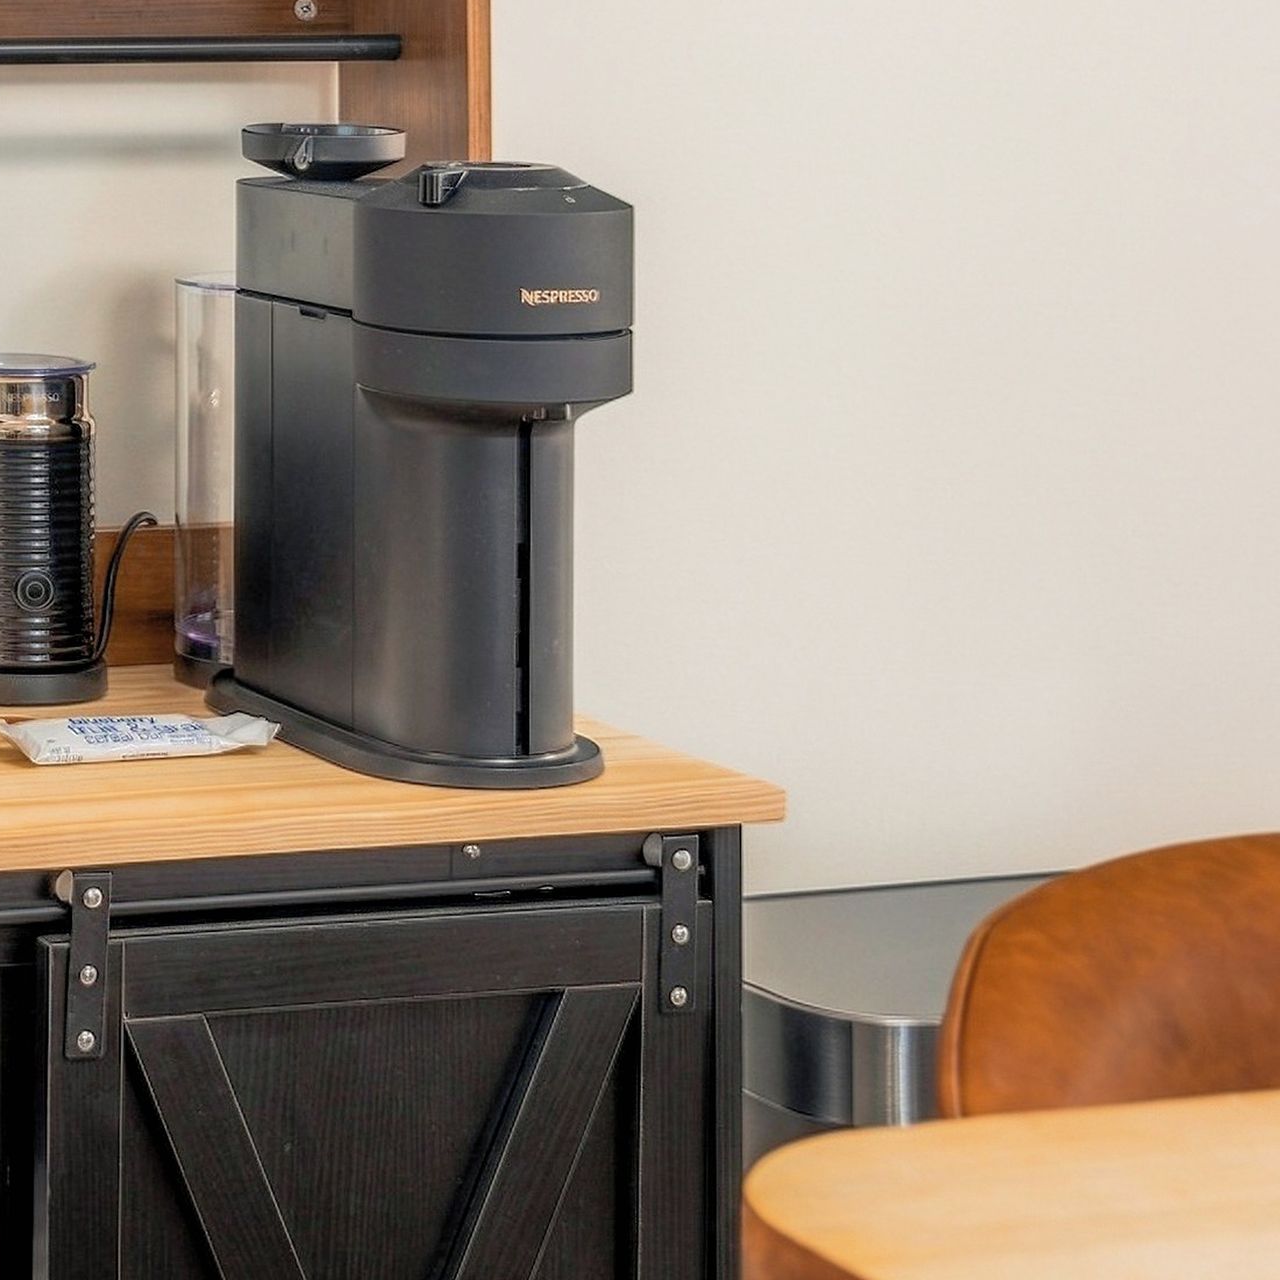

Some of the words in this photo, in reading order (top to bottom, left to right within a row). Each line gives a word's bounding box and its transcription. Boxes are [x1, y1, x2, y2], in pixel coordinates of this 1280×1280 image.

[519, 286, 600, 307] NESPRESSO
[84, 731, 135, 745] cereal
[137, 730, 162, 741] bar
